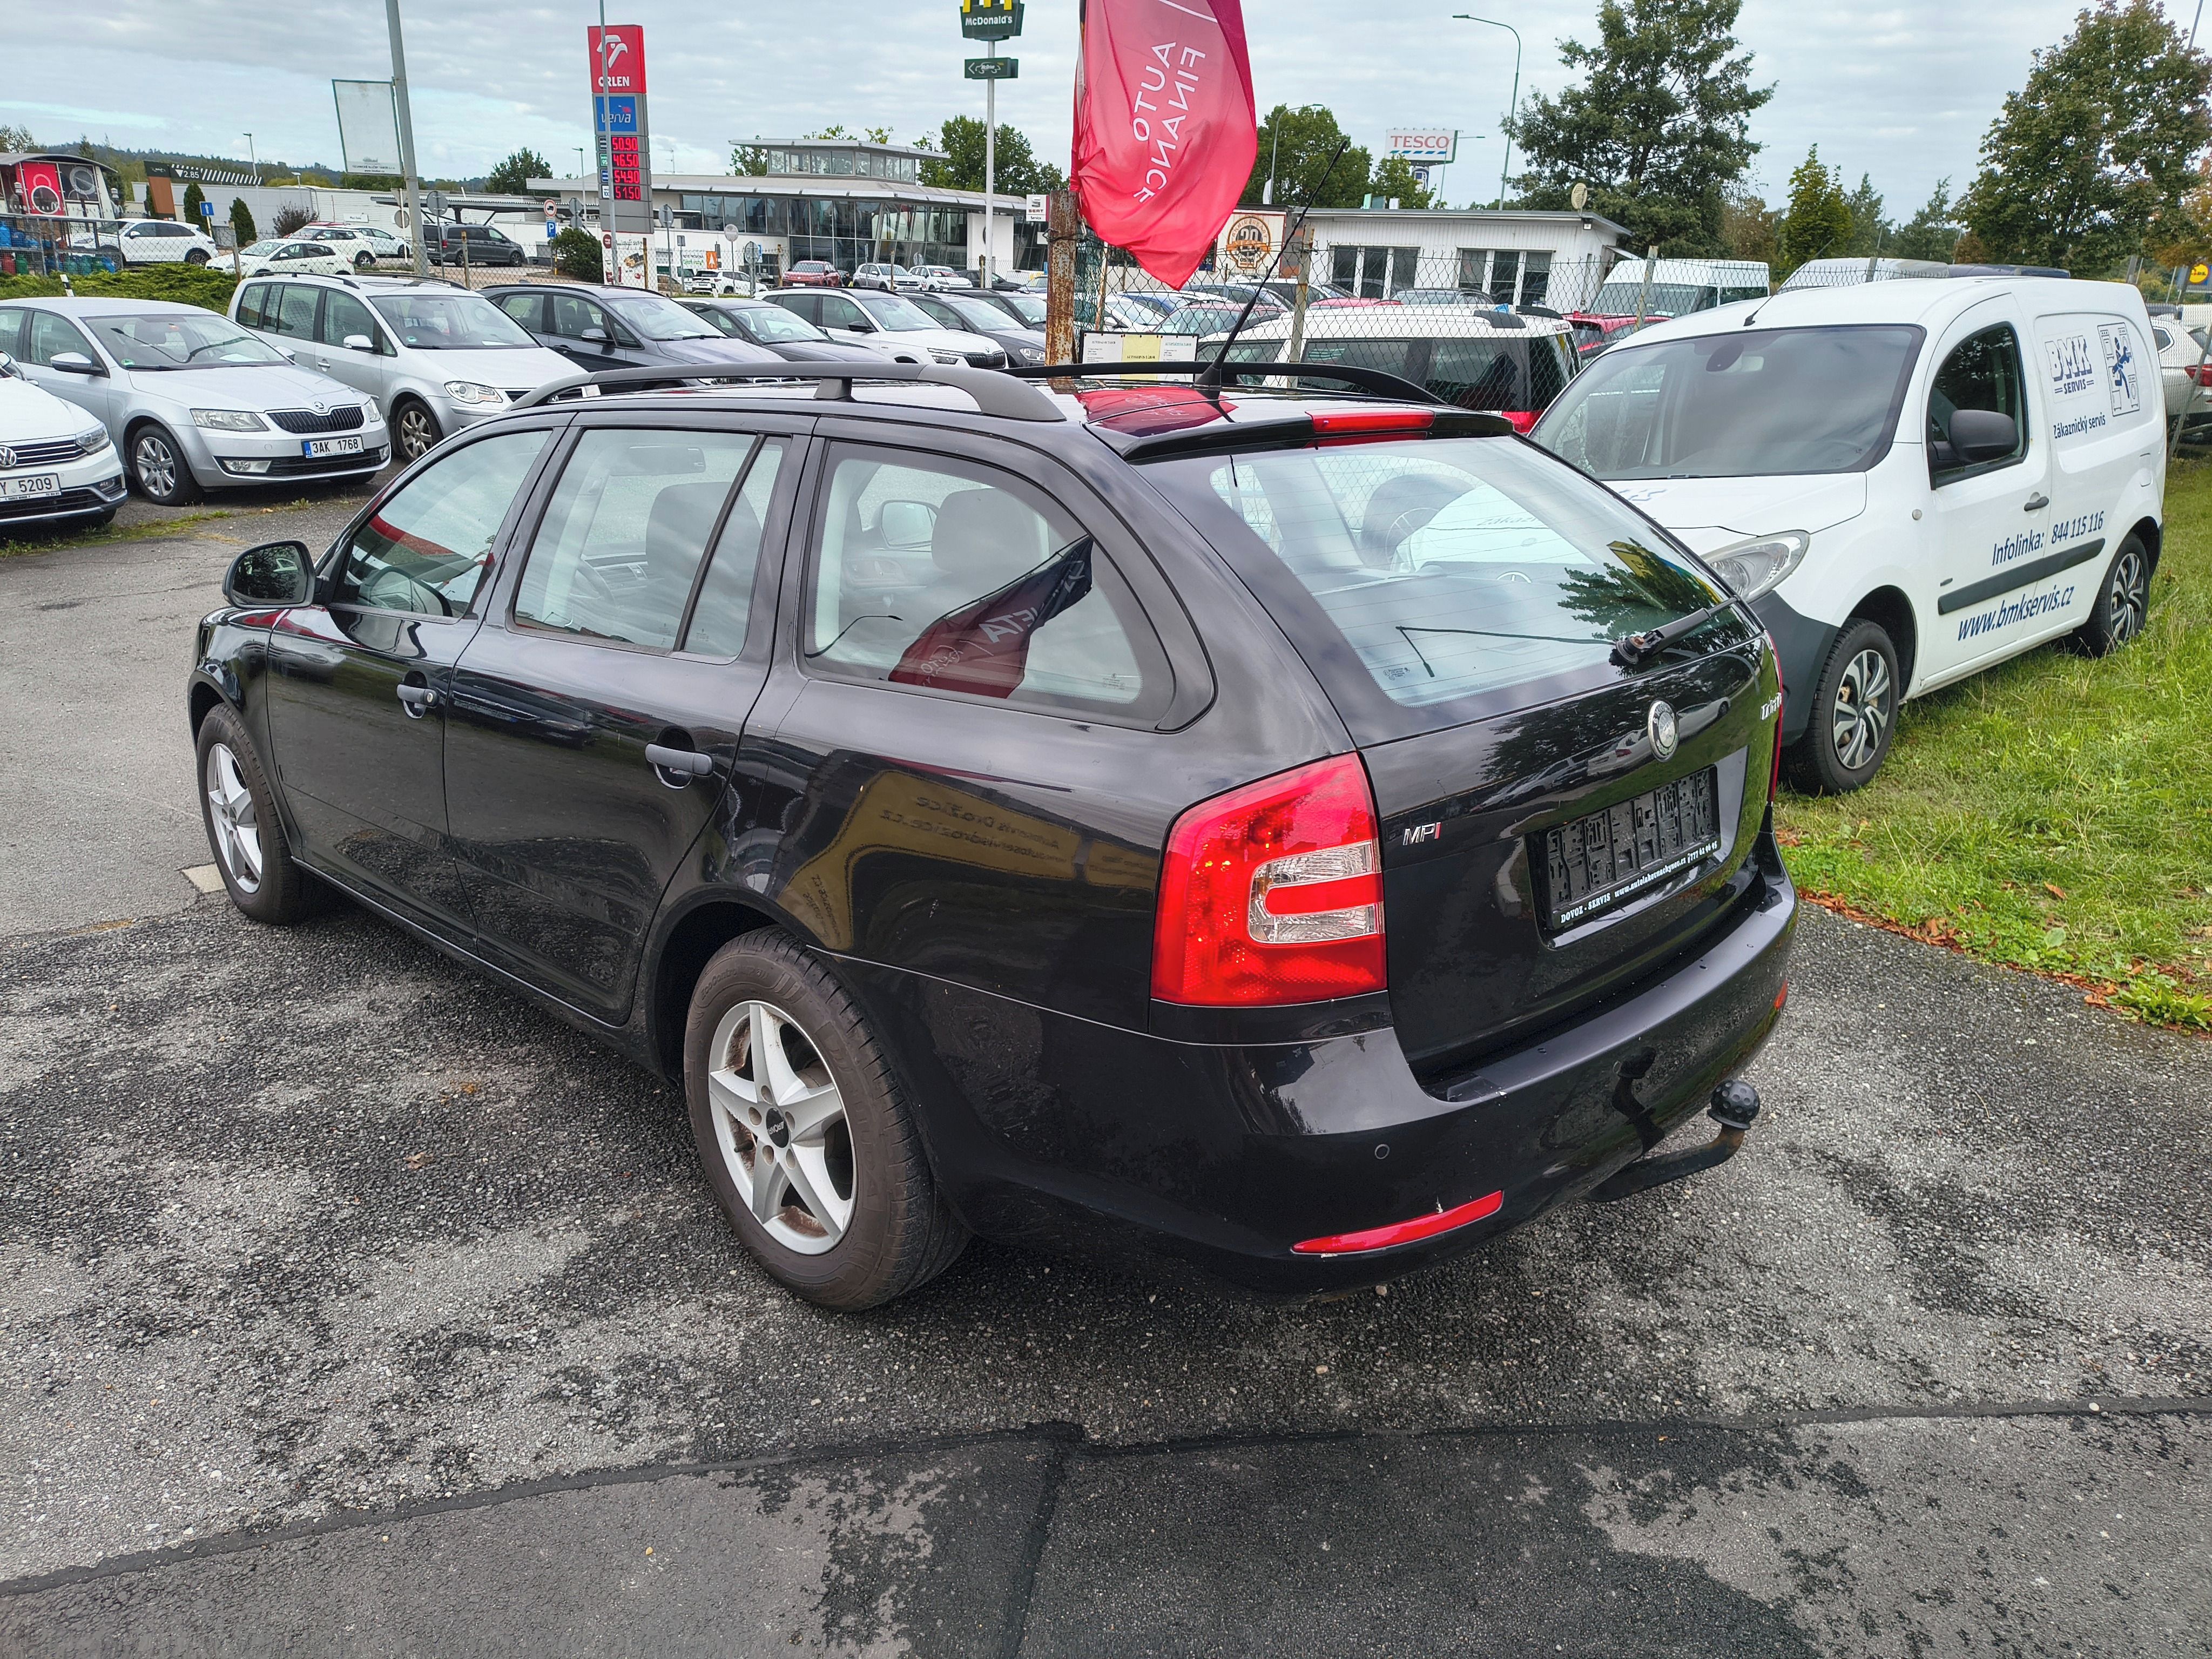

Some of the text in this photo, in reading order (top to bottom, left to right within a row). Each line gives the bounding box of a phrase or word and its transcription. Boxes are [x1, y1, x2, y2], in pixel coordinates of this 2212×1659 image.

[965, 16, 1013, 26] McDonald's
[598, 76, 630, 87] ORLEN
[612, 137, 638, 151] 50.90
[1390, 136, 1449, 149] TESCO
[613, 153, 639, 167] 46.50
[184, 170, 199, 179] 2.85
[614, 170, 640, 184] 54.90
[548, 222, 555, 233] P
[2045, 335, 2092, 382] BMK
[2063, 379, 2086, 394] SERVIS
[2053, 412, 2106, 439] Zákaznický servis
[313, 441, 330, 453] 3AK
[338, 439, 359, 451] 1768
[18, 477, 52, 493] 5209
[1992, 511, 2104, 566] Infolinka: 844 115 116
[1958, 585, 2074, 641] www.bmkservis.cz
[1402, 822, 1441, 845] MPI
[1561, 906, 1583, 923] DOVOZ
[1588, 892, 1610, 911] SERVIS
